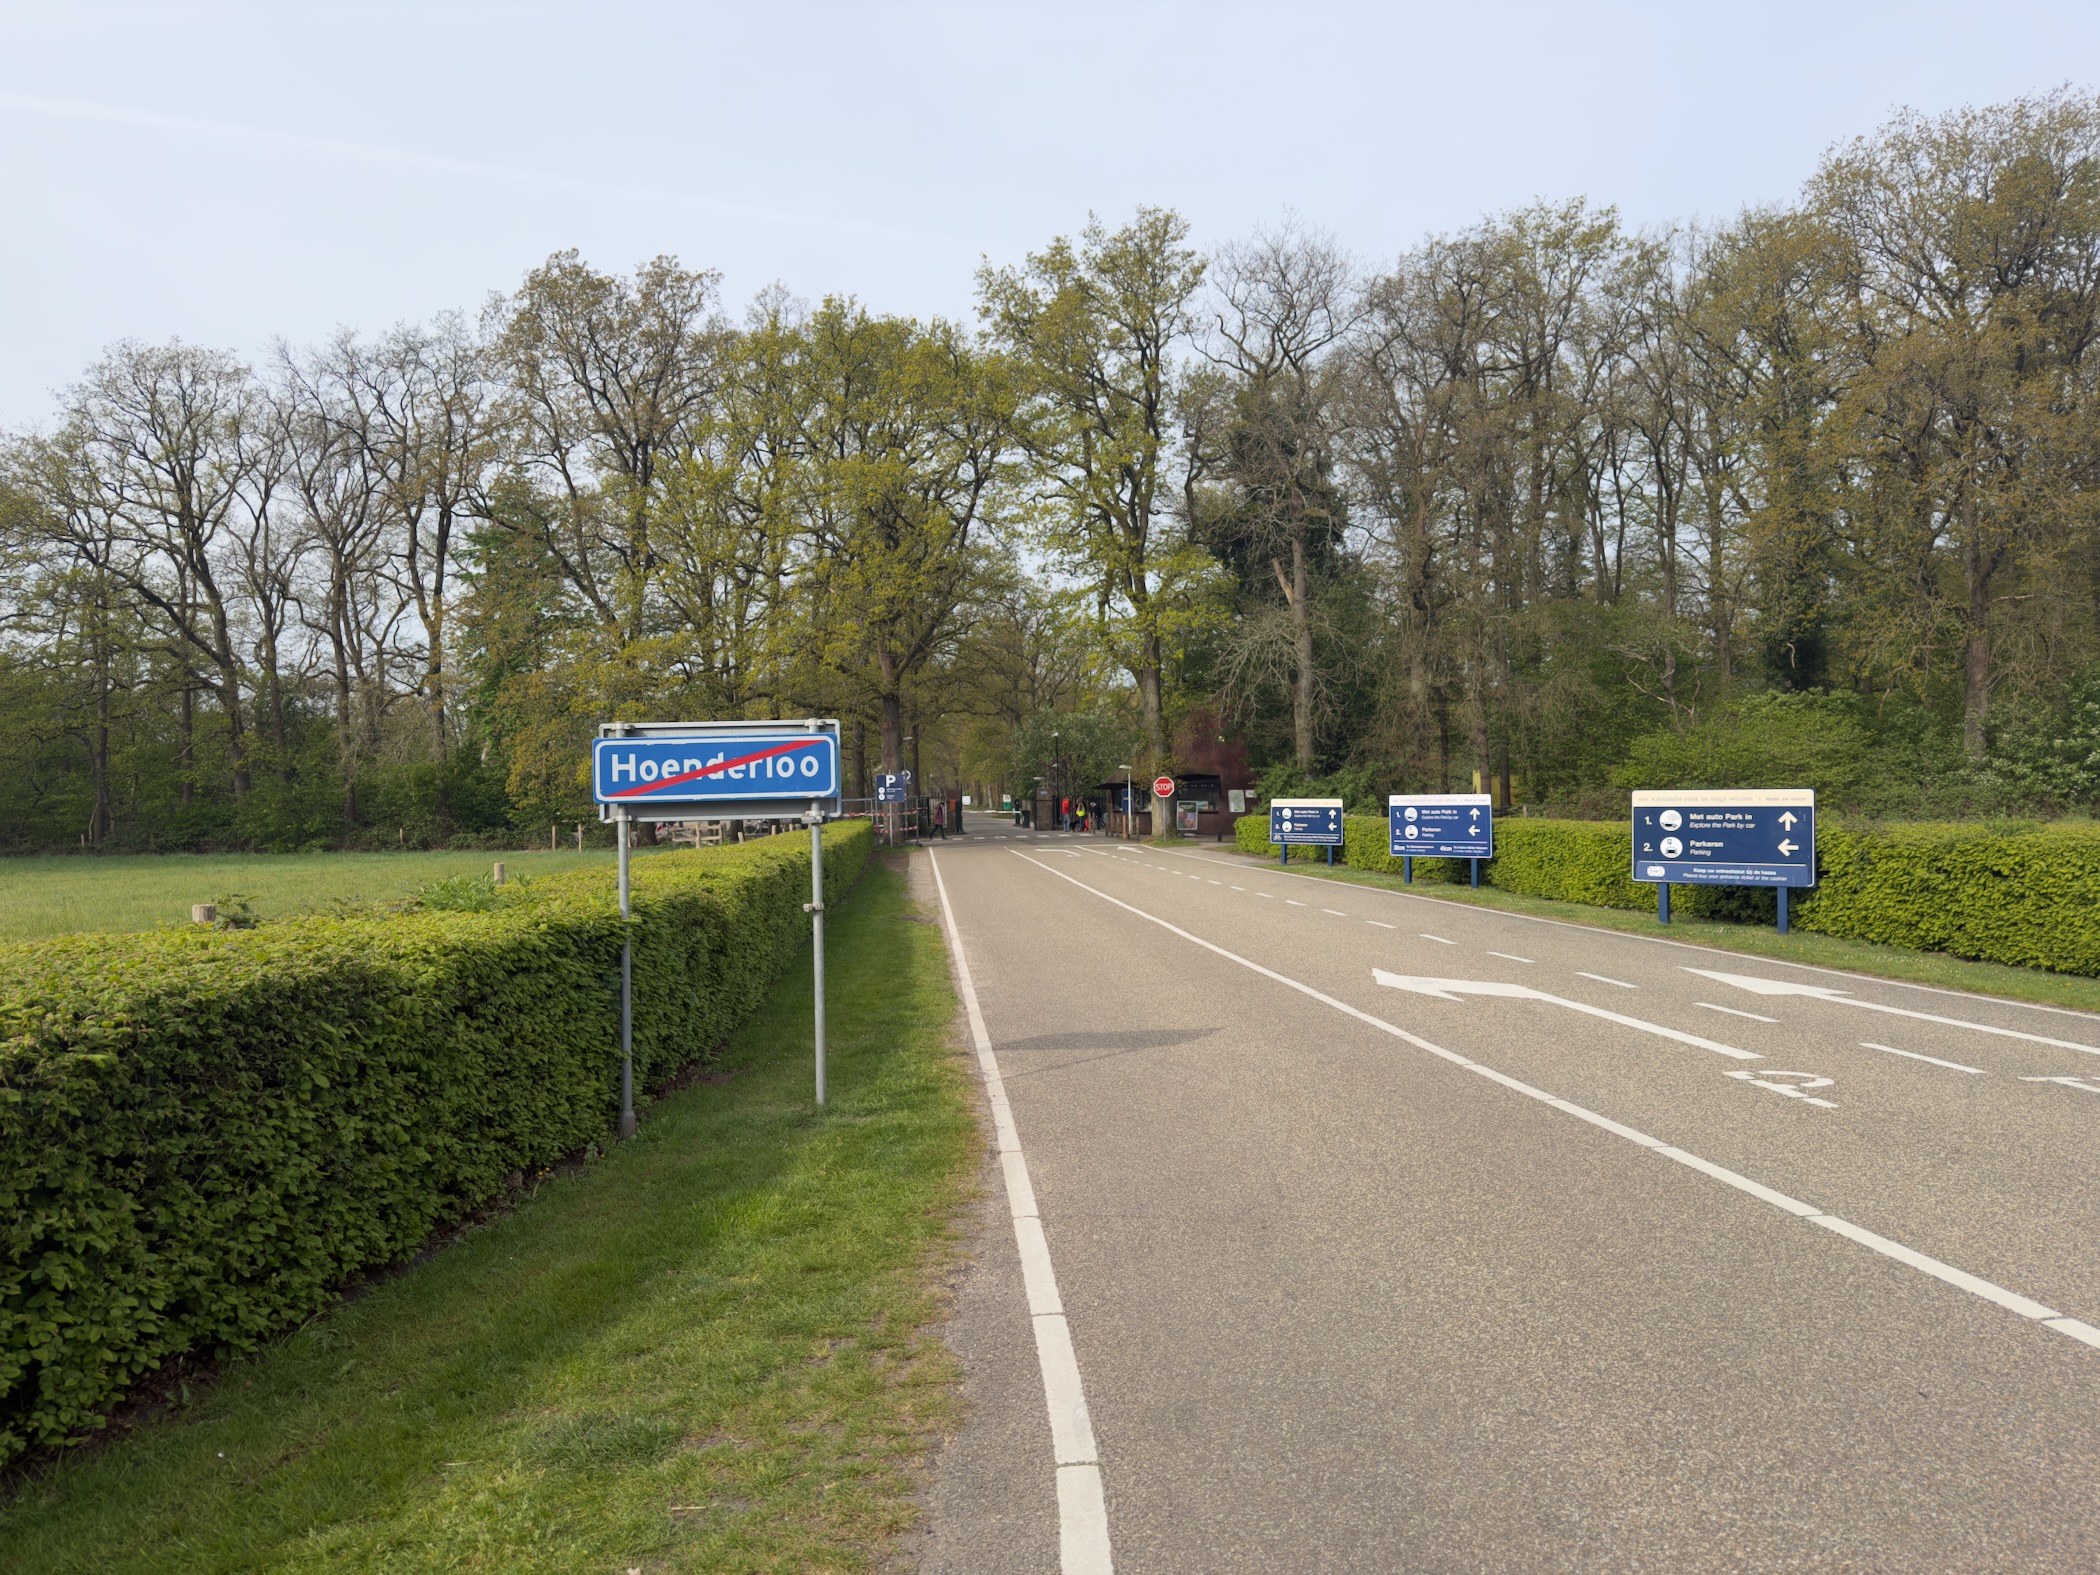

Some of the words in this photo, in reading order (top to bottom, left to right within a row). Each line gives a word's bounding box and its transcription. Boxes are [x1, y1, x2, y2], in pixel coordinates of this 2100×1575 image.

[611, 752, 819, 782] Hoenderloo
[885, 774, 896, 787] P
[1156, 783, 1172, 791] STOP
[1644, 816, 1653, 825] 1.
[1643, 843, 1653, 852] 2.
